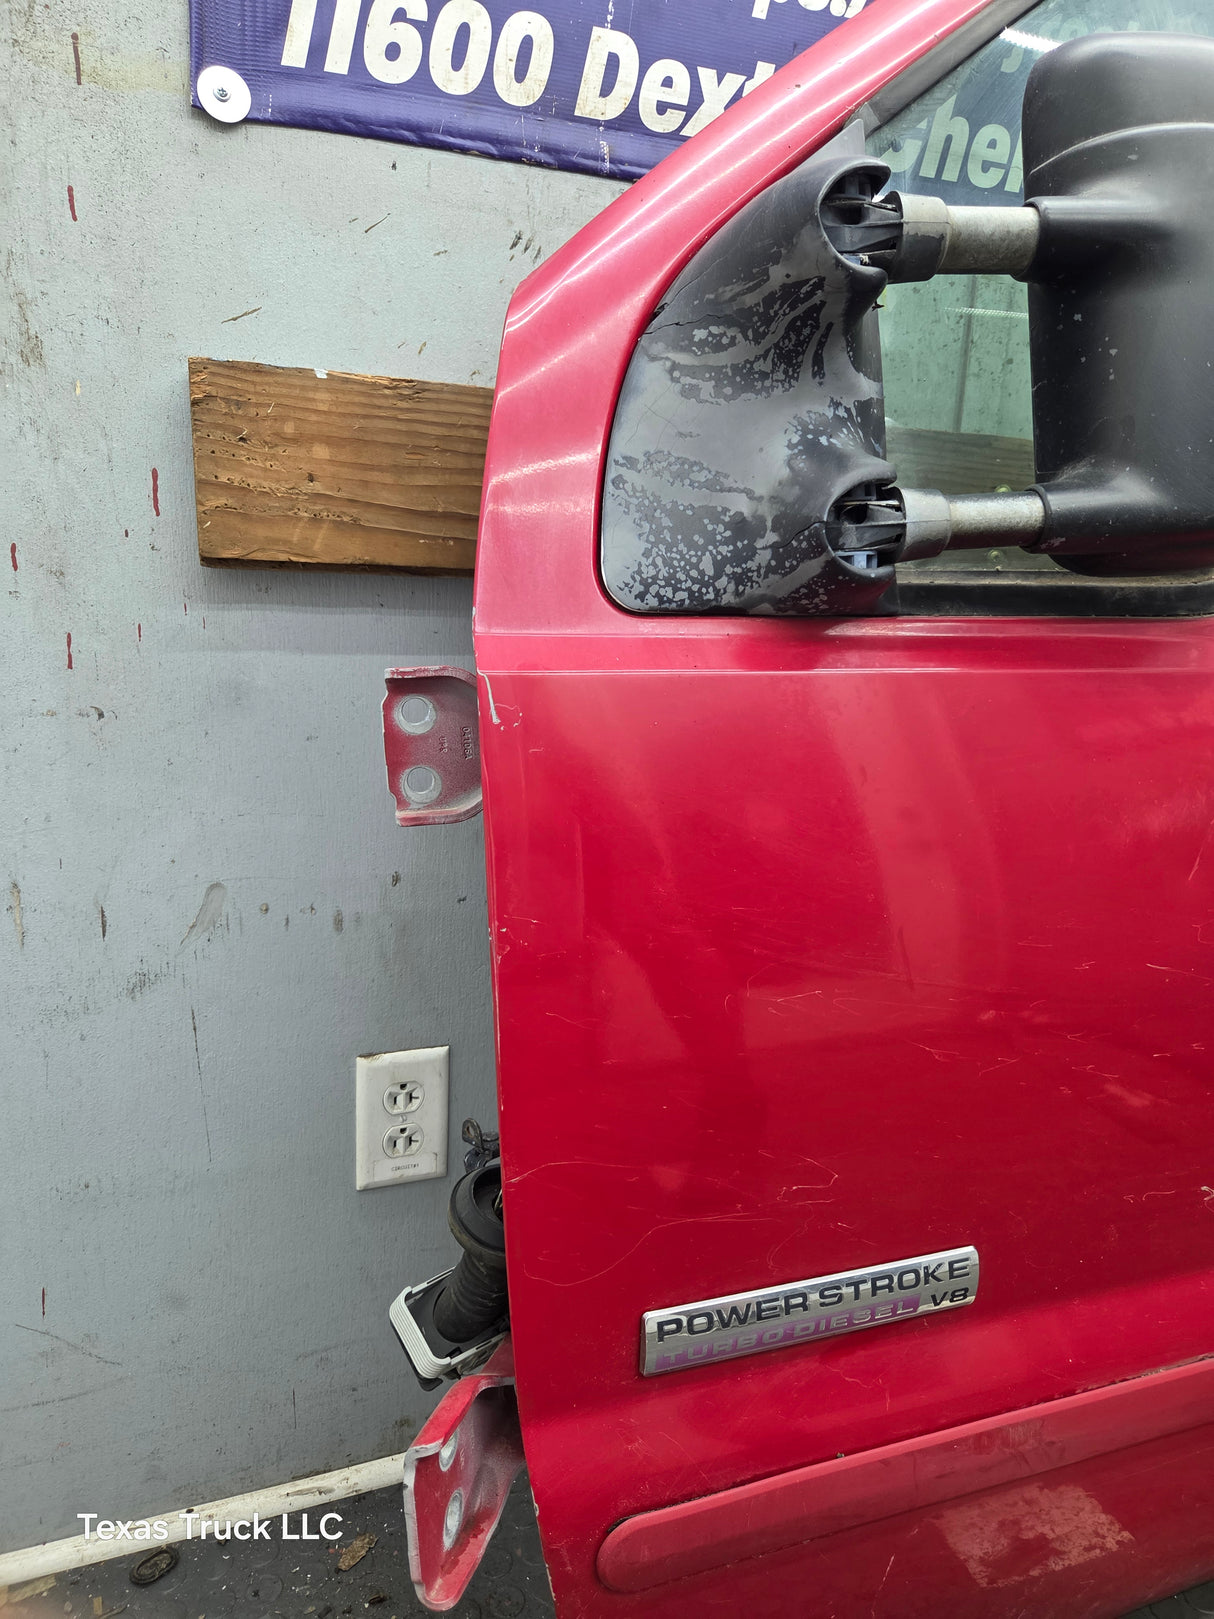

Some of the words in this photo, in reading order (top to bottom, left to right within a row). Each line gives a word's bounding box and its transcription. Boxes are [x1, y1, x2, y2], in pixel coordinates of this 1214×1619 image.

[281, 0, 554, 106] 11600
[656, 1292, 808, 1343] POWER
[819, 1257, 970, 1308] STROKE
[931, 1287, 969, 1307] V8
